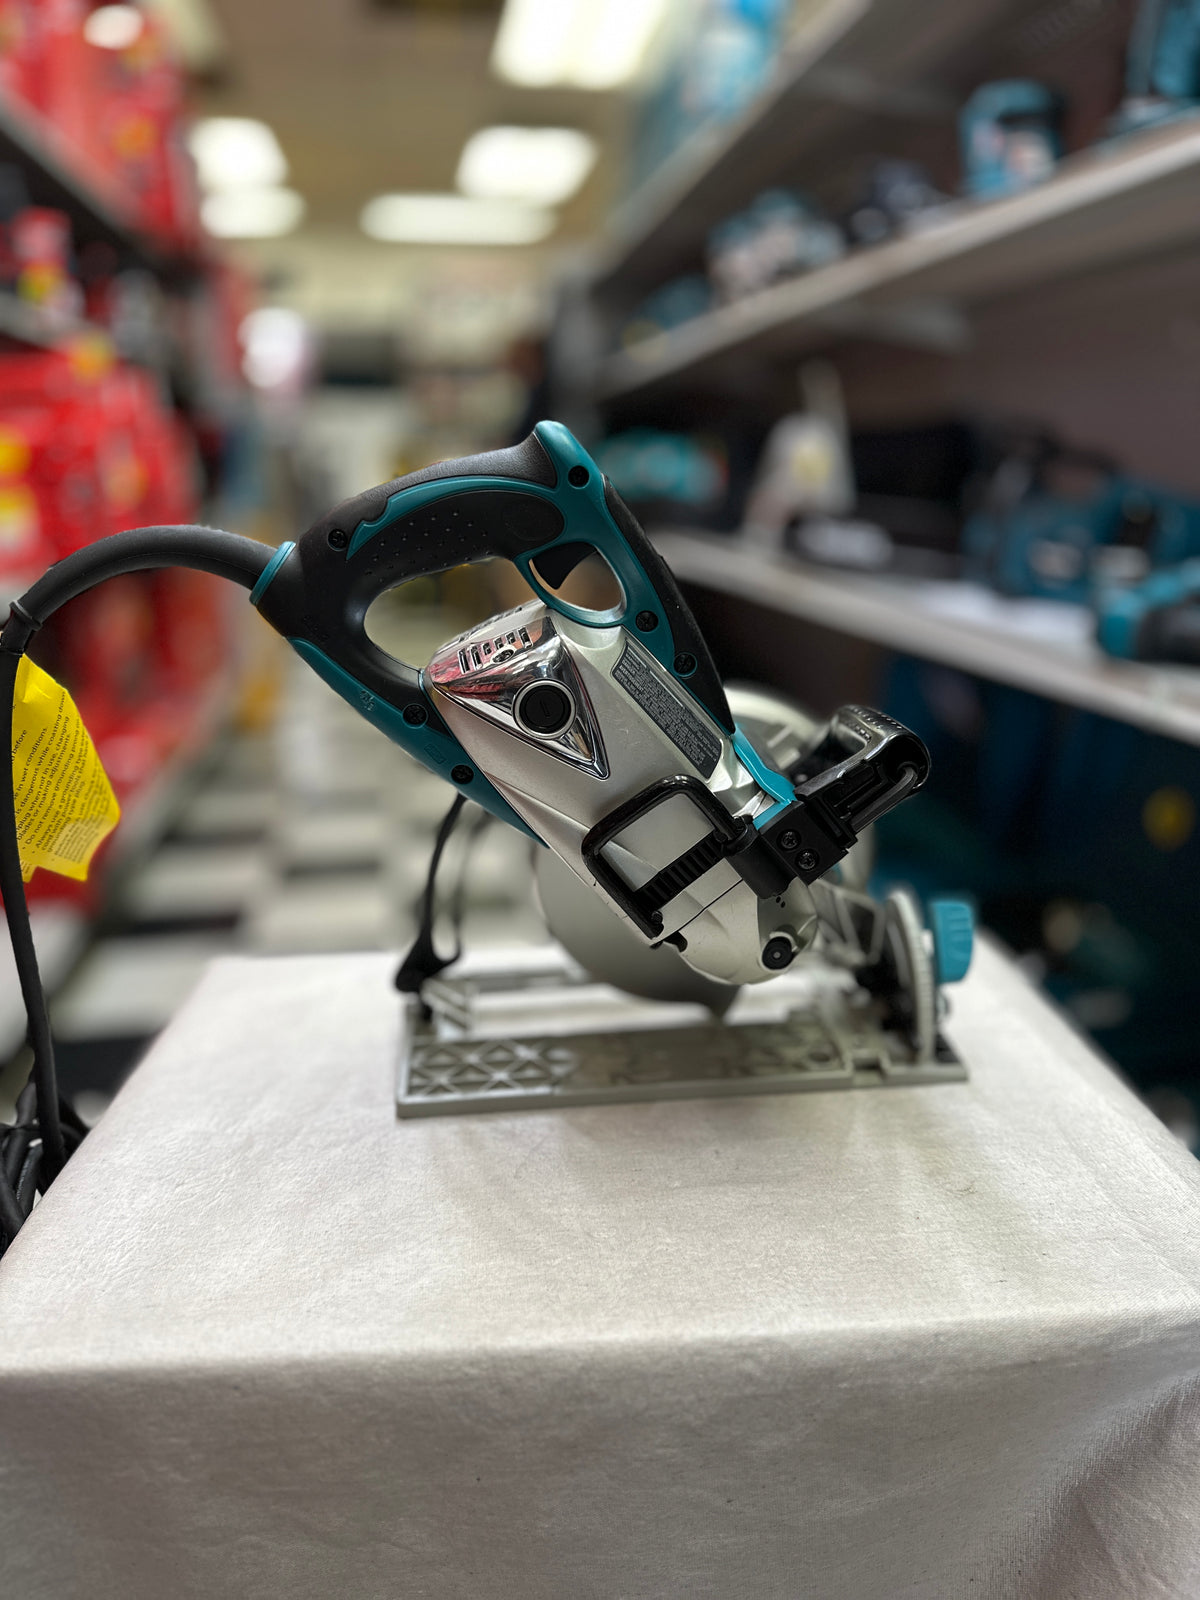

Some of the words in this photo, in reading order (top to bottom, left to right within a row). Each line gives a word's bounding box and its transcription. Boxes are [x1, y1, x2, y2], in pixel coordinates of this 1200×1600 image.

[11, 729, 27, 754] before
[20, 767, 38, 807] dangerous
[36, 747, 50, 767] while
[48, 714, 62, 746] coasting
[29, 791, 42, 811] when
[55, 716, 70, 750] changing
[17, 818, 35, 840] blades
[33, 809, 40, 817] or
[38, 780, 51, 808] making
[25, 834, 36, 844] Do
[34, 821, 43, 833] not
[42, 792, 56, 820] remove
[55, 753, 74, 791] grounding
[36, 824, 53, 848] Always
[51, 810, 60, 823] use
[60, 765, 80, 803] grounding
